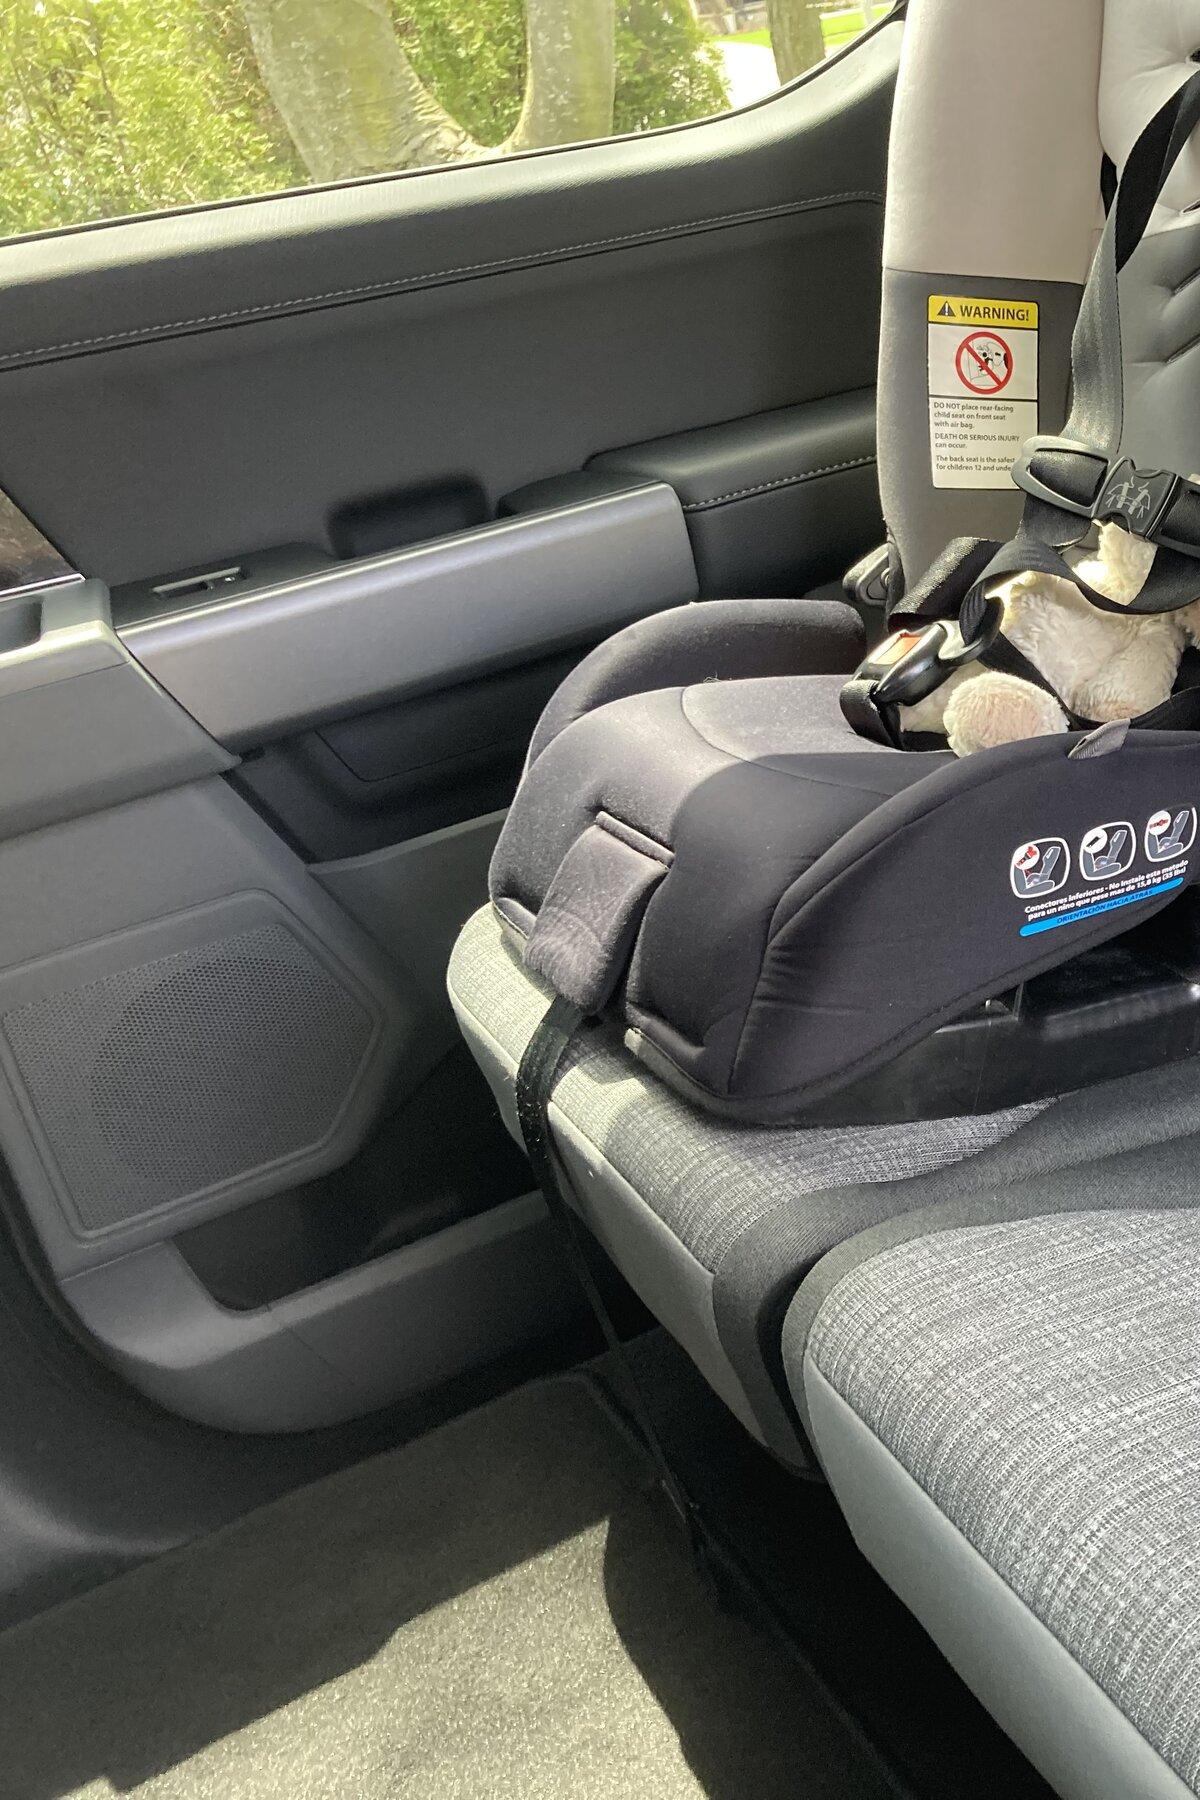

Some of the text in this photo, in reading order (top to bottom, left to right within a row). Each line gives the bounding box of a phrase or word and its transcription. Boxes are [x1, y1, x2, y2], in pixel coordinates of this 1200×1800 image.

[960, 305, 1029, 321] WARNING!
[962, 403, 978, 411] place
[980, 405, 1014, 413] rear-facing
[1025, 897, 1068, 914] Conectores
[1109, 882, 1119, 890] No
[1146, 870, 1161, 879] esta
[1028, 911, 1045, 921] para
[1076, 898, 1090, 907] que
[1091, 892, 1108, 904] pese
[1110, 888, 1125, 897] mas
[1106, 897, 1128, 907] HACIA
